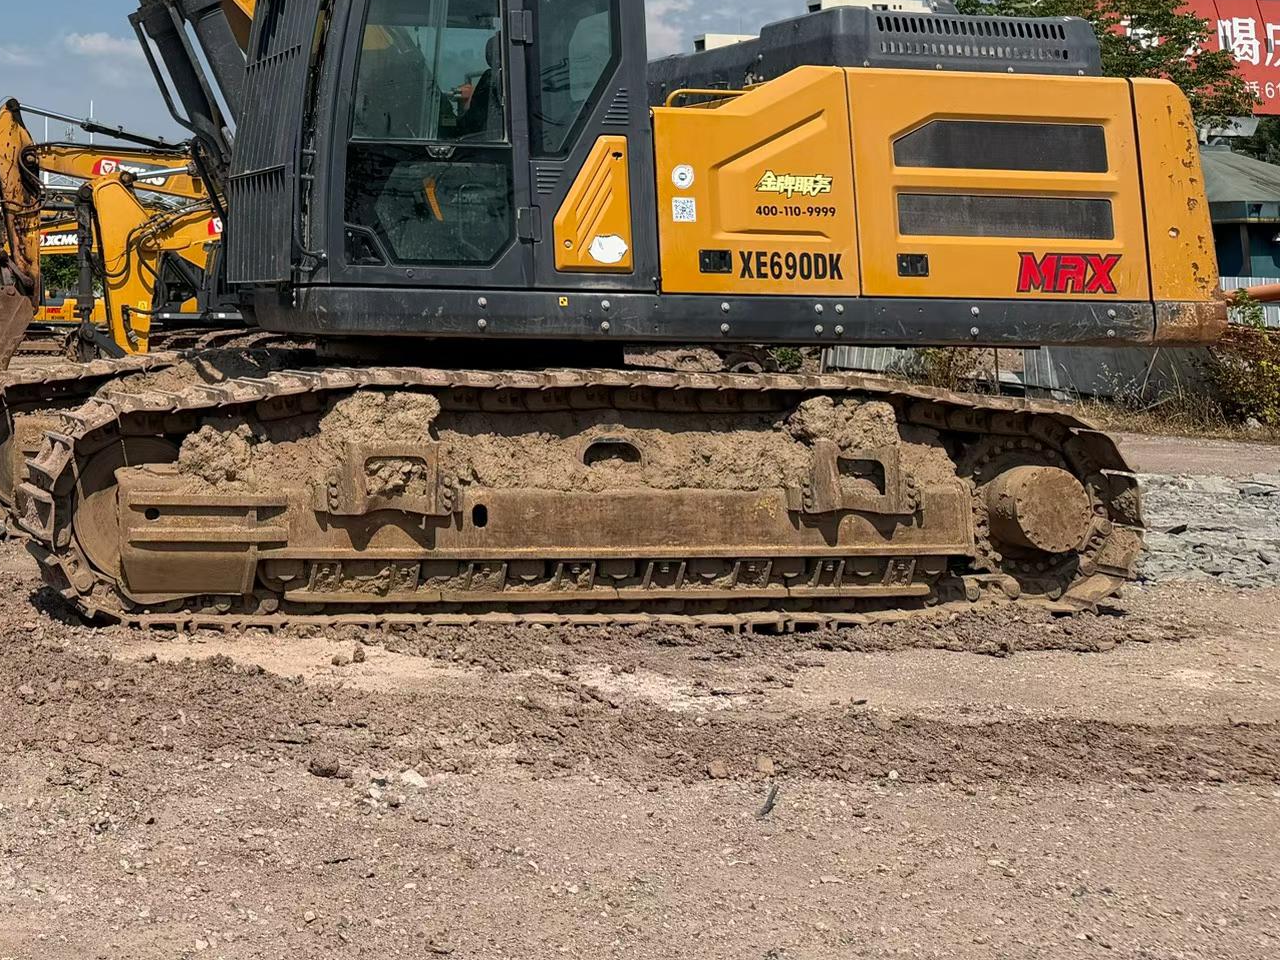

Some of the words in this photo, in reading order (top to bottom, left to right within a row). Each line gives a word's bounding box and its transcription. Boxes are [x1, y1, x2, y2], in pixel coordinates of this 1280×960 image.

[755, 170, 834, 199] 金牌服务
[755, 205, 837, 217] 400-110-9999
[739, 250, 843, 280] XE690DK
